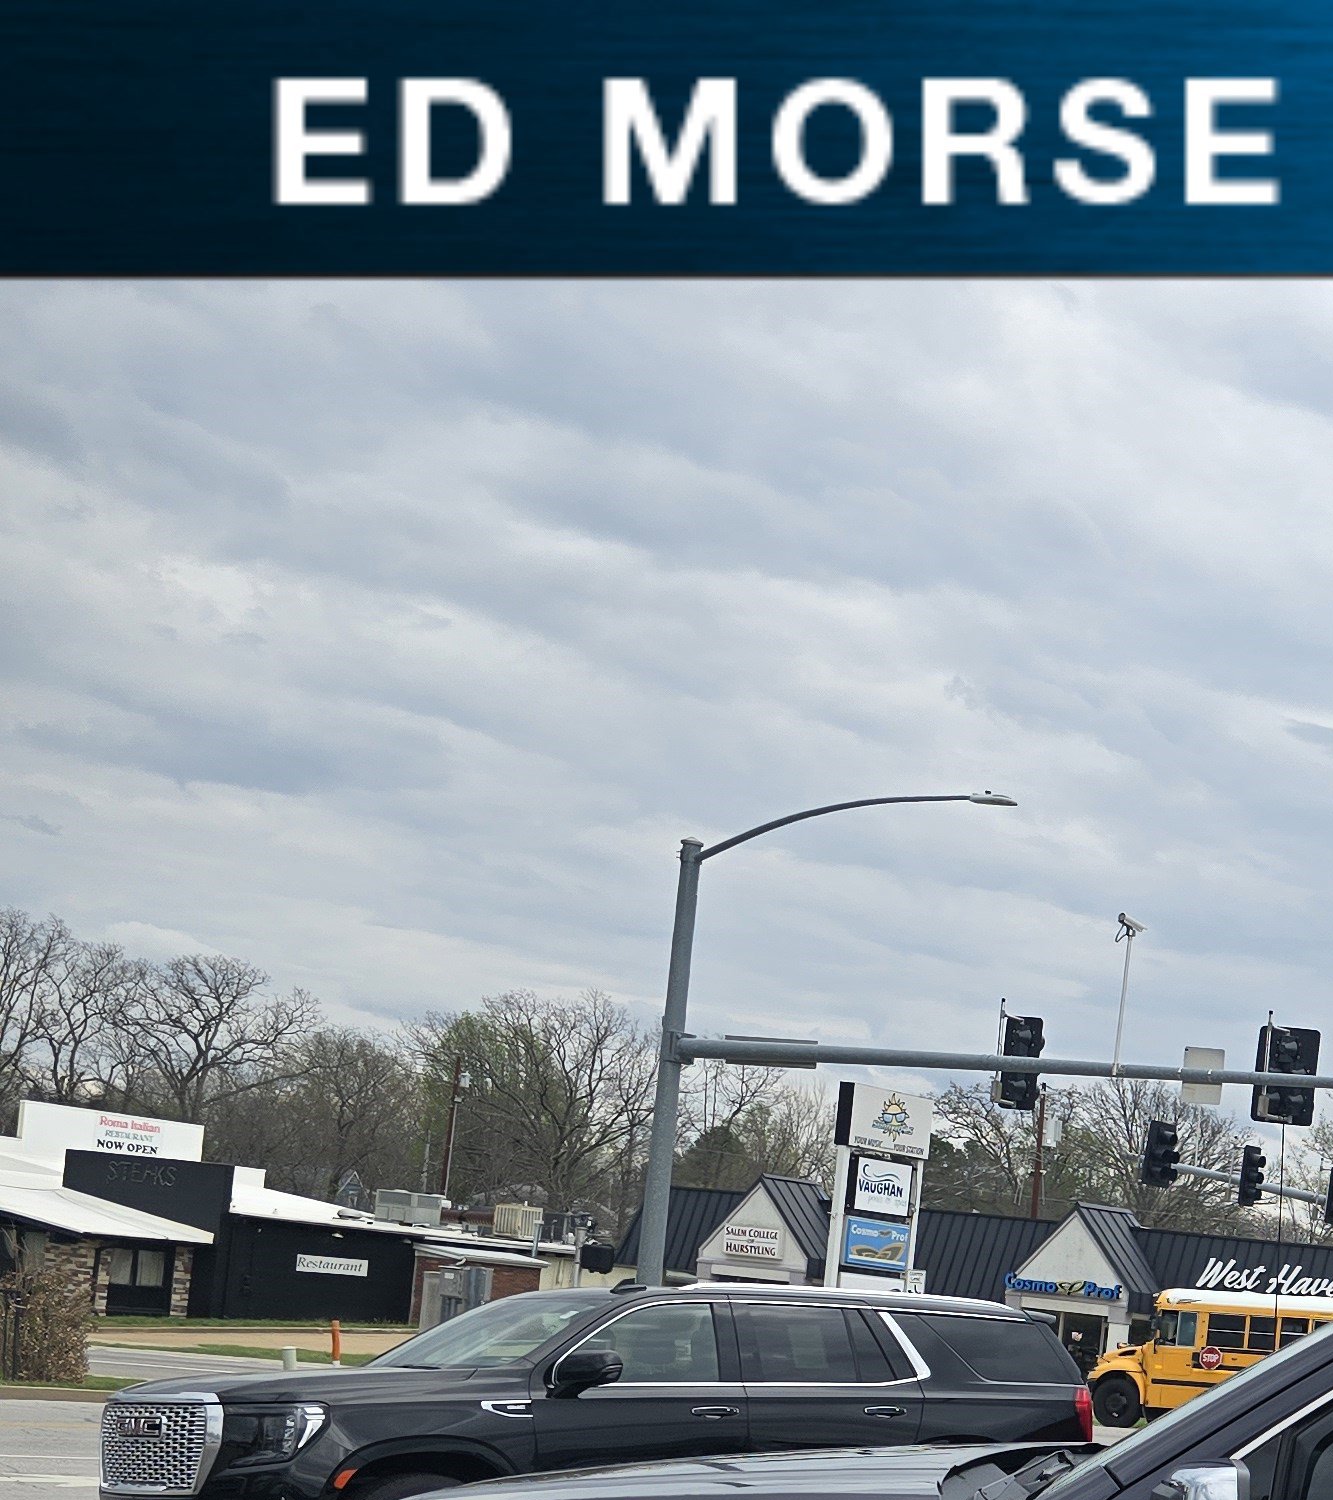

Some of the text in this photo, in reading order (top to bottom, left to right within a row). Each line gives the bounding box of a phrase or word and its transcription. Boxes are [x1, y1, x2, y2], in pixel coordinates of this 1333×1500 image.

[100, 1115, 161, 1134] Roma Italian
[96, 1138, 159, 1155] NOW OPEN
[105, 1160, 178, 1187] STEAKS
[858, 1178, 904, 1198] VAUGHAN
[851, 1223, 909, 1242] Cosmo Prof
[297, 1256, 363, 1272] Restaurant
[1195, 1257, 1267, 1289] West
[1004, 1271, 1123, 1300] Cosmo Prof
[1202, 1353, 1220, 1363] STOP
[117, 1417, 161, 1435] GMC
